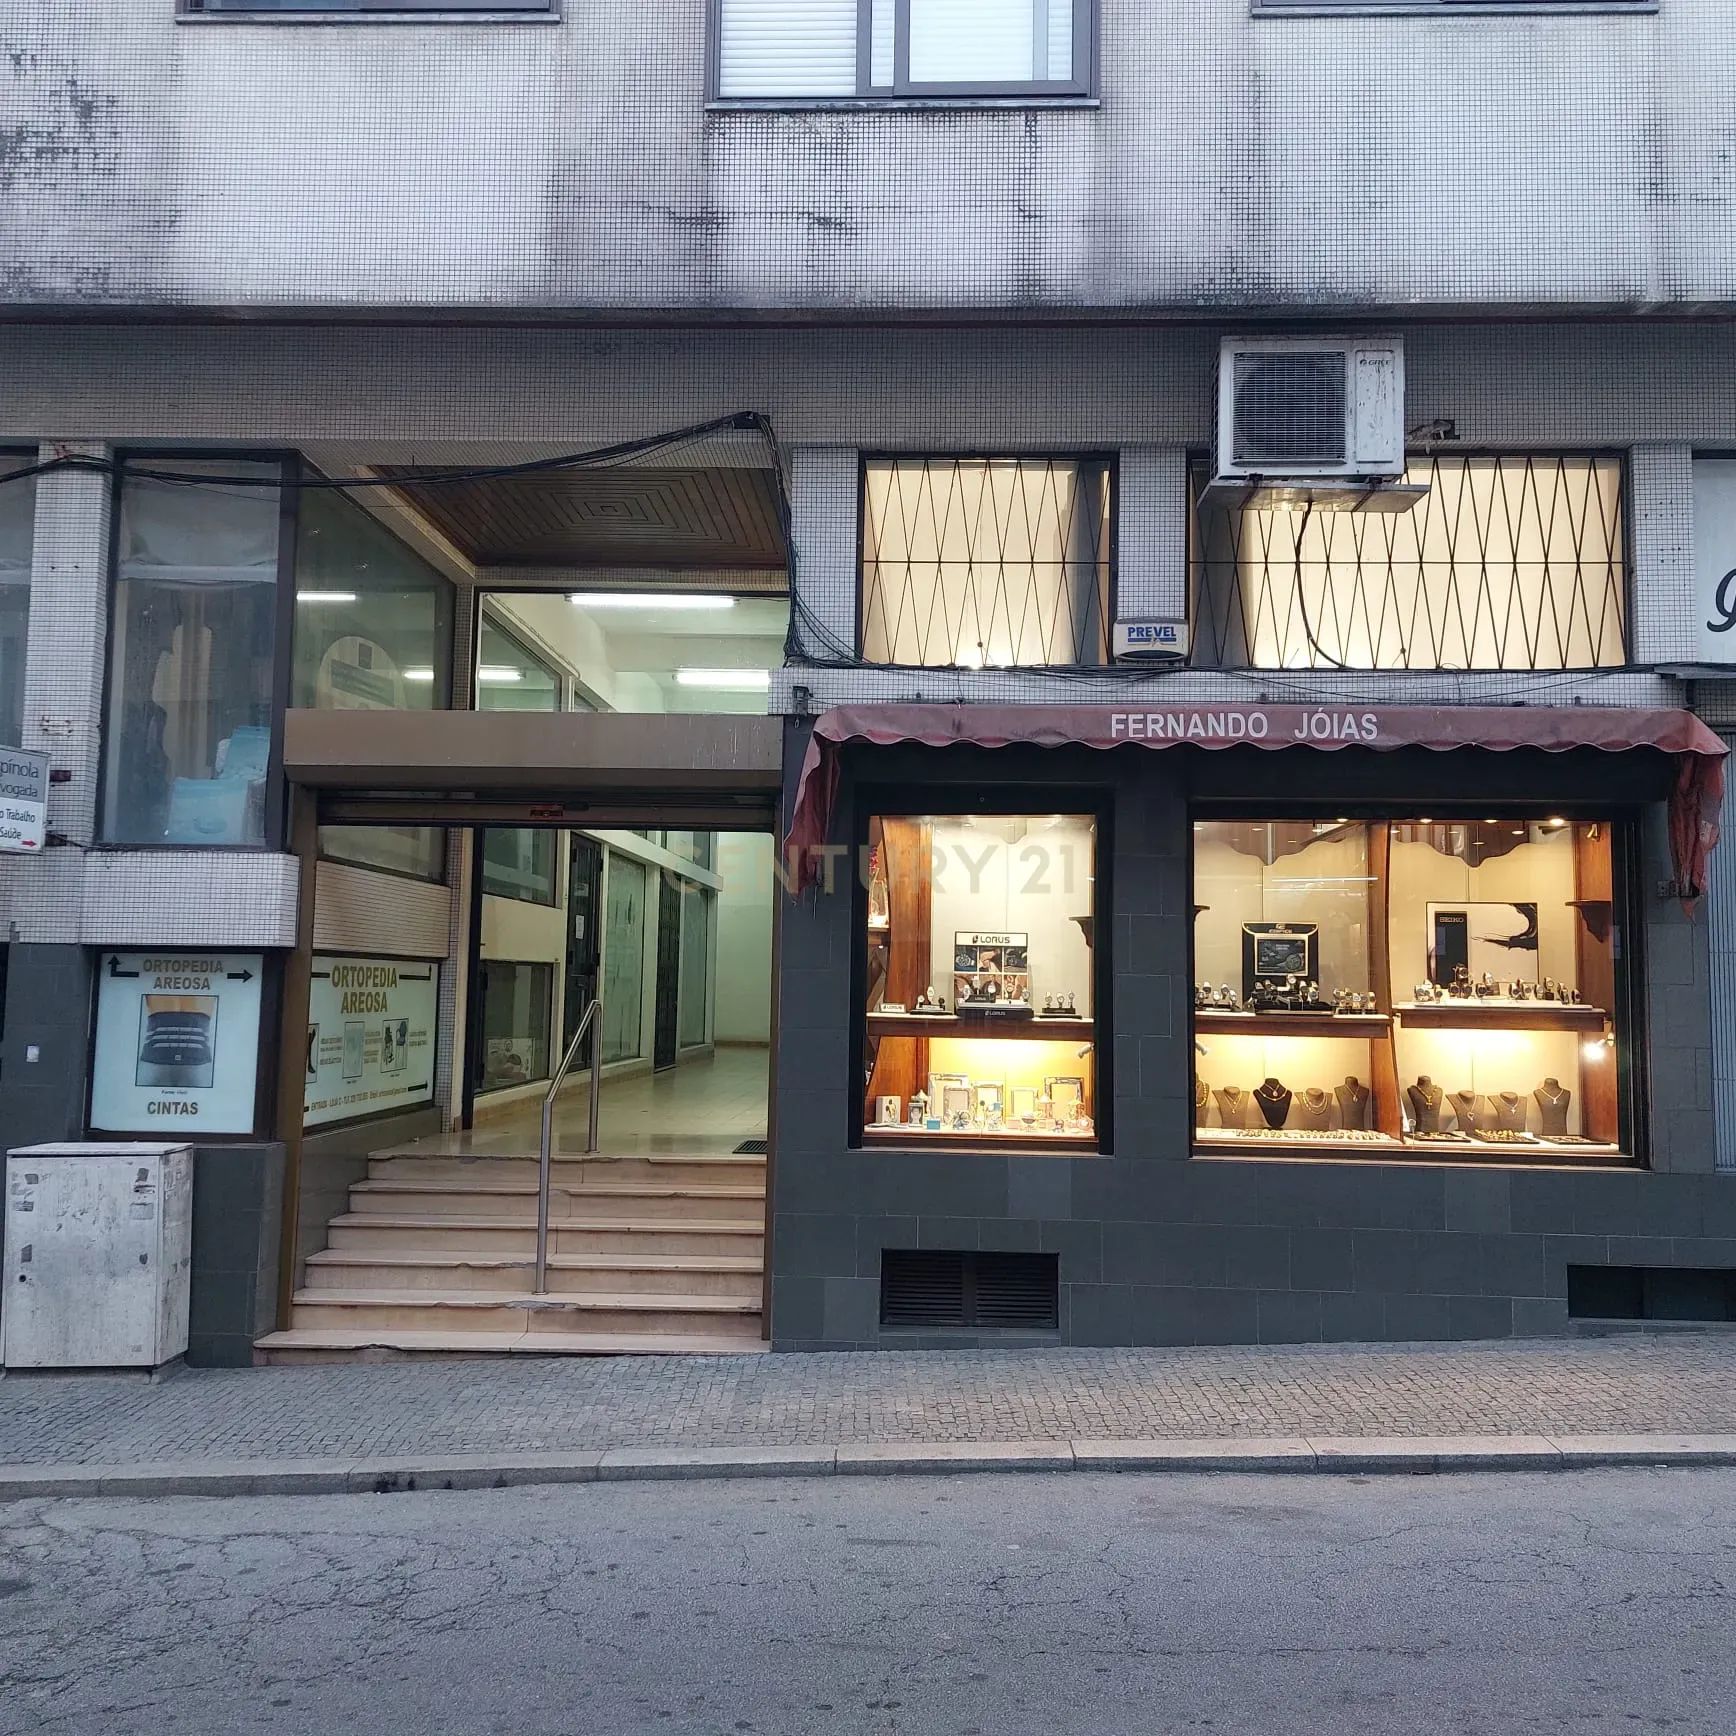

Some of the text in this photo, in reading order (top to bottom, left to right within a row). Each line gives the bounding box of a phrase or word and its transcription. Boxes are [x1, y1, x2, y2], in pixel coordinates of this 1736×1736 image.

[1127, 626, 1176, 637] PREVEL
[1110, 707, 1378, 740] FERNANDO JÓIAS
[6, 808, 36, 823] Trabalho
[980, 936, 1011, 944] LORUS
[143, 960, 224, 973] ORTOPEDIA
[153, 977, 211, 990] AREOSA
[331, 965, 398, 988] ORTOPEDIA
[341, 991, 388, 1014] AREOSA
[147, 1101, 198, 1115] CINTAS
